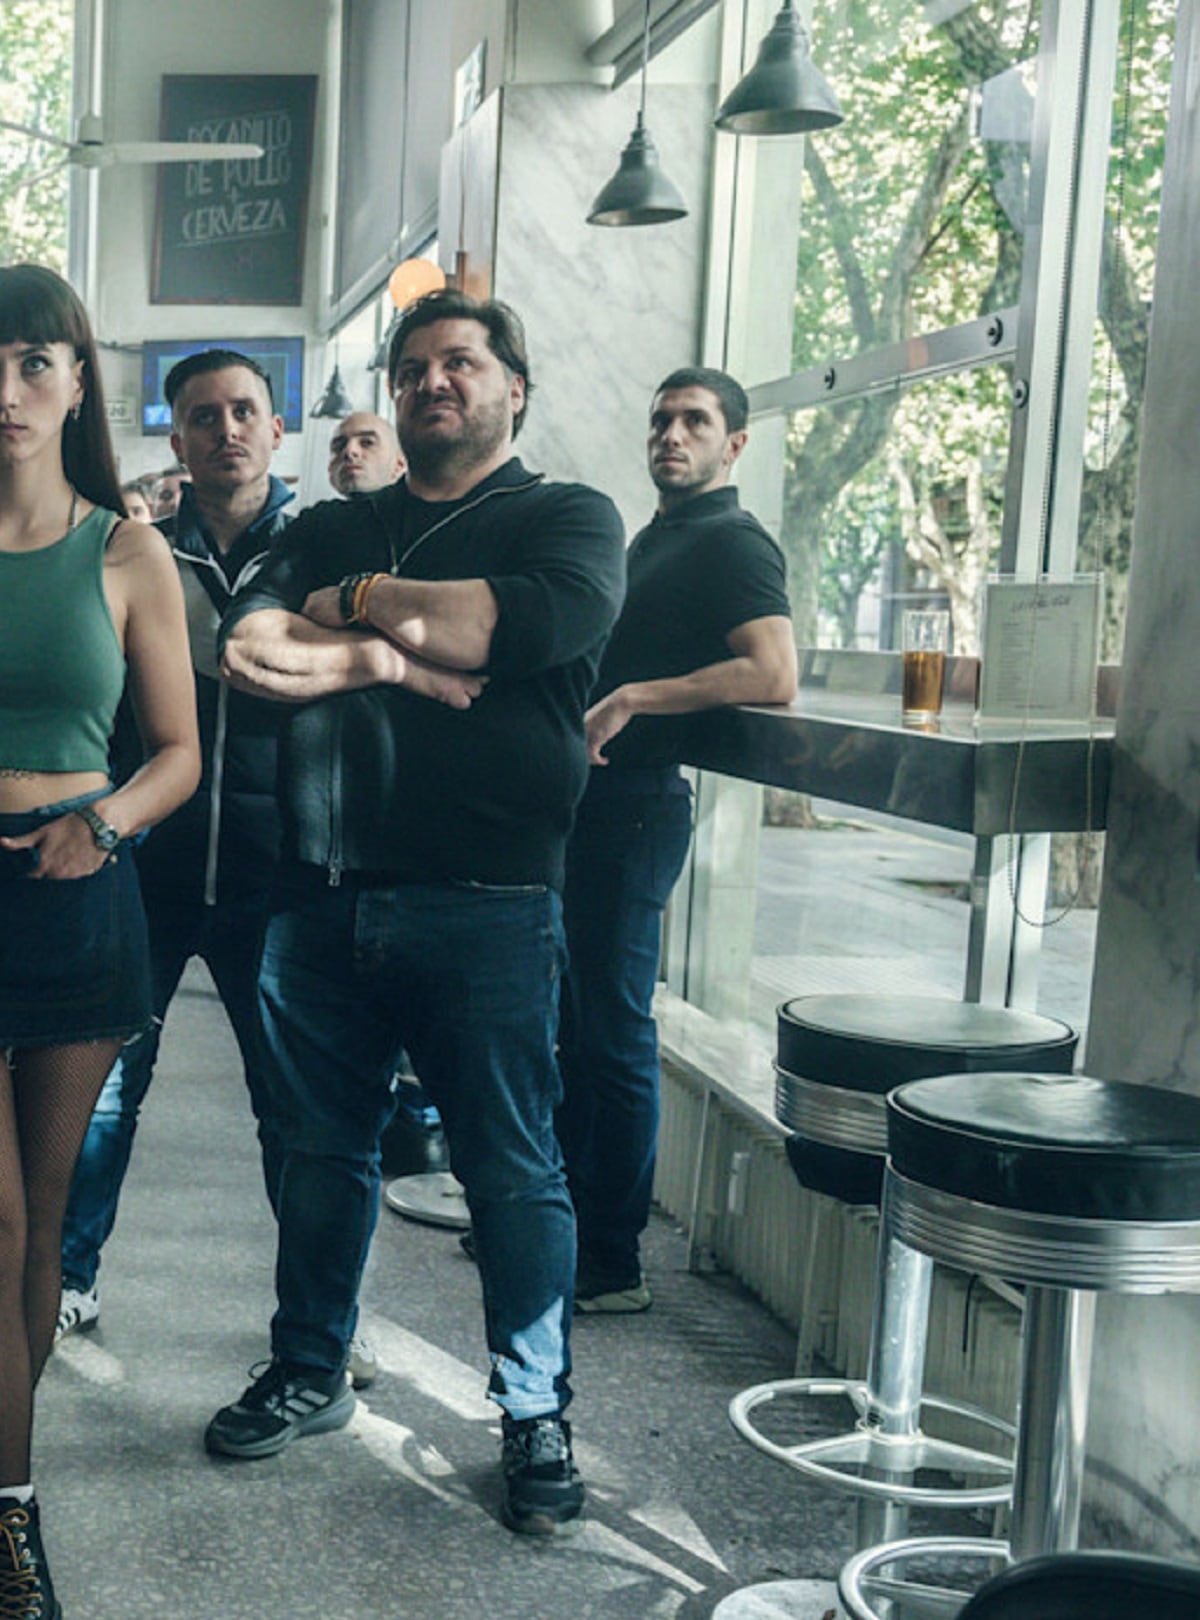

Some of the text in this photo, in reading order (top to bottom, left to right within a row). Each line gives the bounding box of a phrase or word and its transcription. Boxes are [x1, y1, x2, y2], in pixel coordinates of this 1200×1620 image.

[185, 150, 292, 198] DE POLLO
[182, 198, 287, 239] CERVEZA
